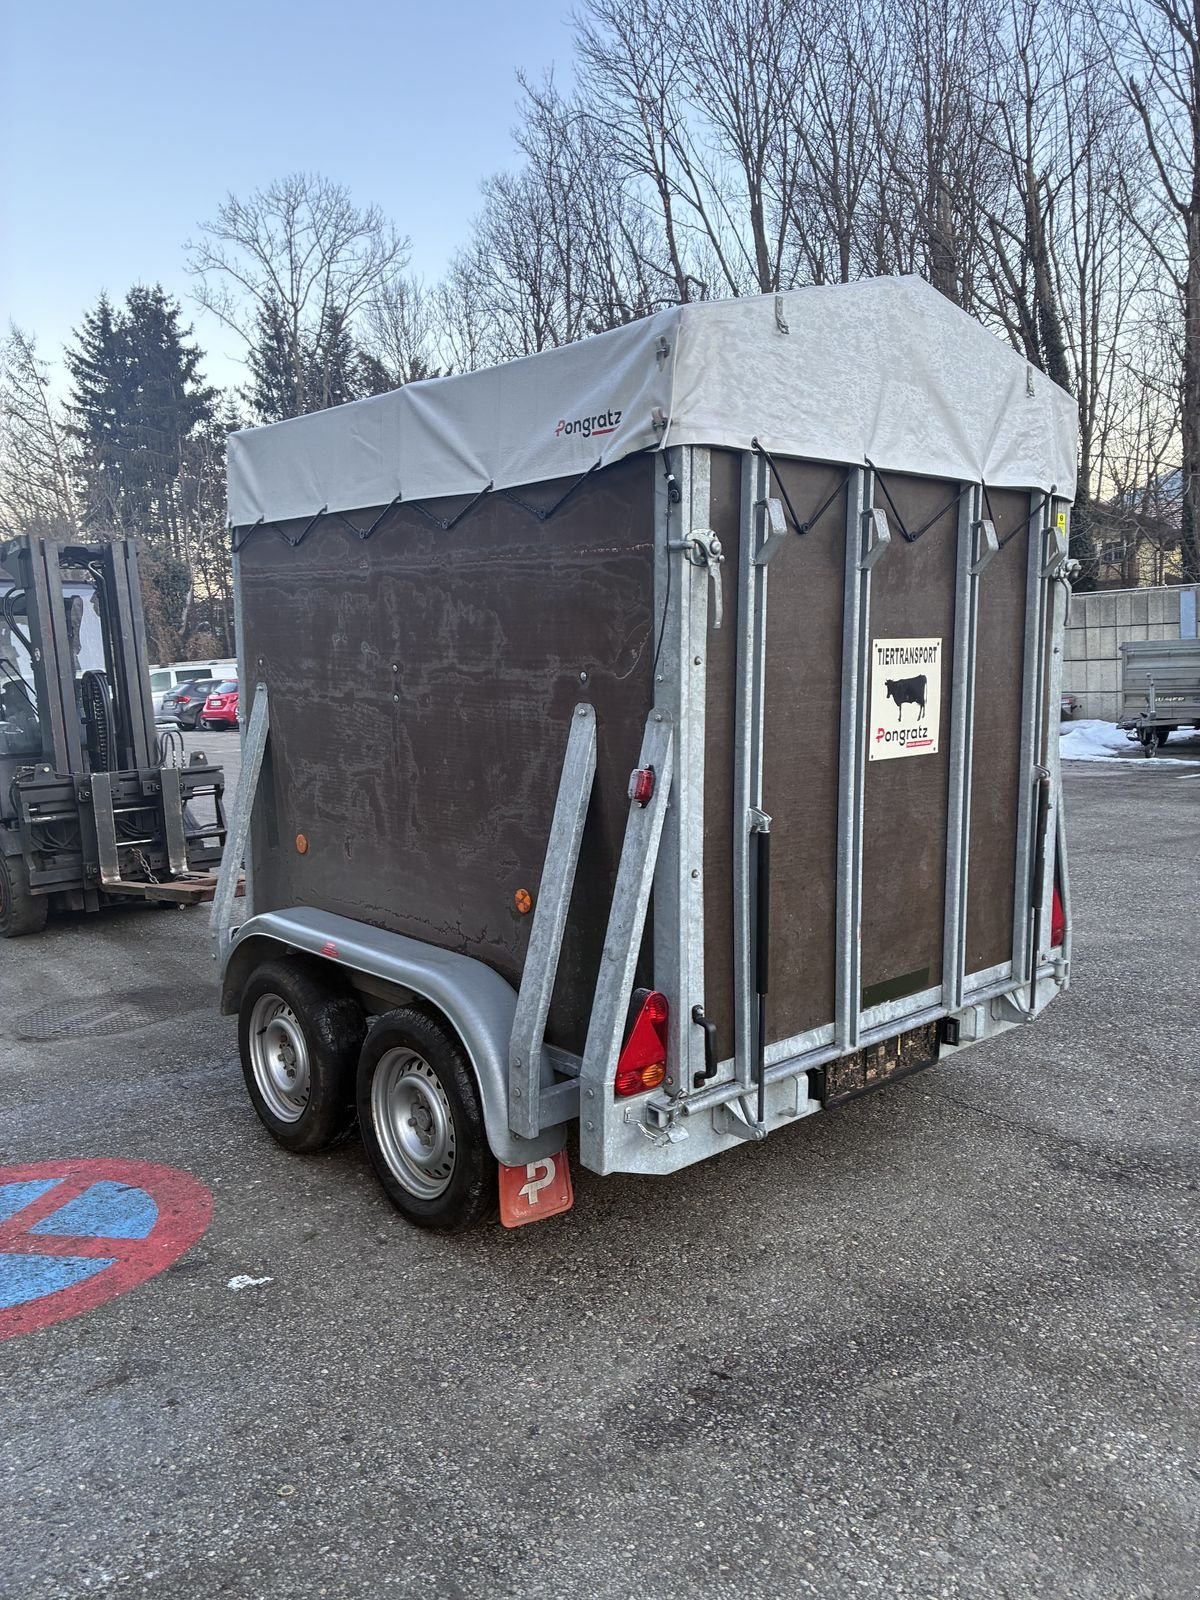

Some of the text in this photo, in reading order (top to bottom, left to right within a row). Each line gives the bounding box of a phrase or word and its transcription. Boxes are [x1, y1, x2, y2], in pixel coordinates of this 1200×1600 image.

[555, 408, 622, 438] Pongratz
[877, 646, 937, 665] TIERTRANSPORT
[875, 726, 928, 746] Pongratz
